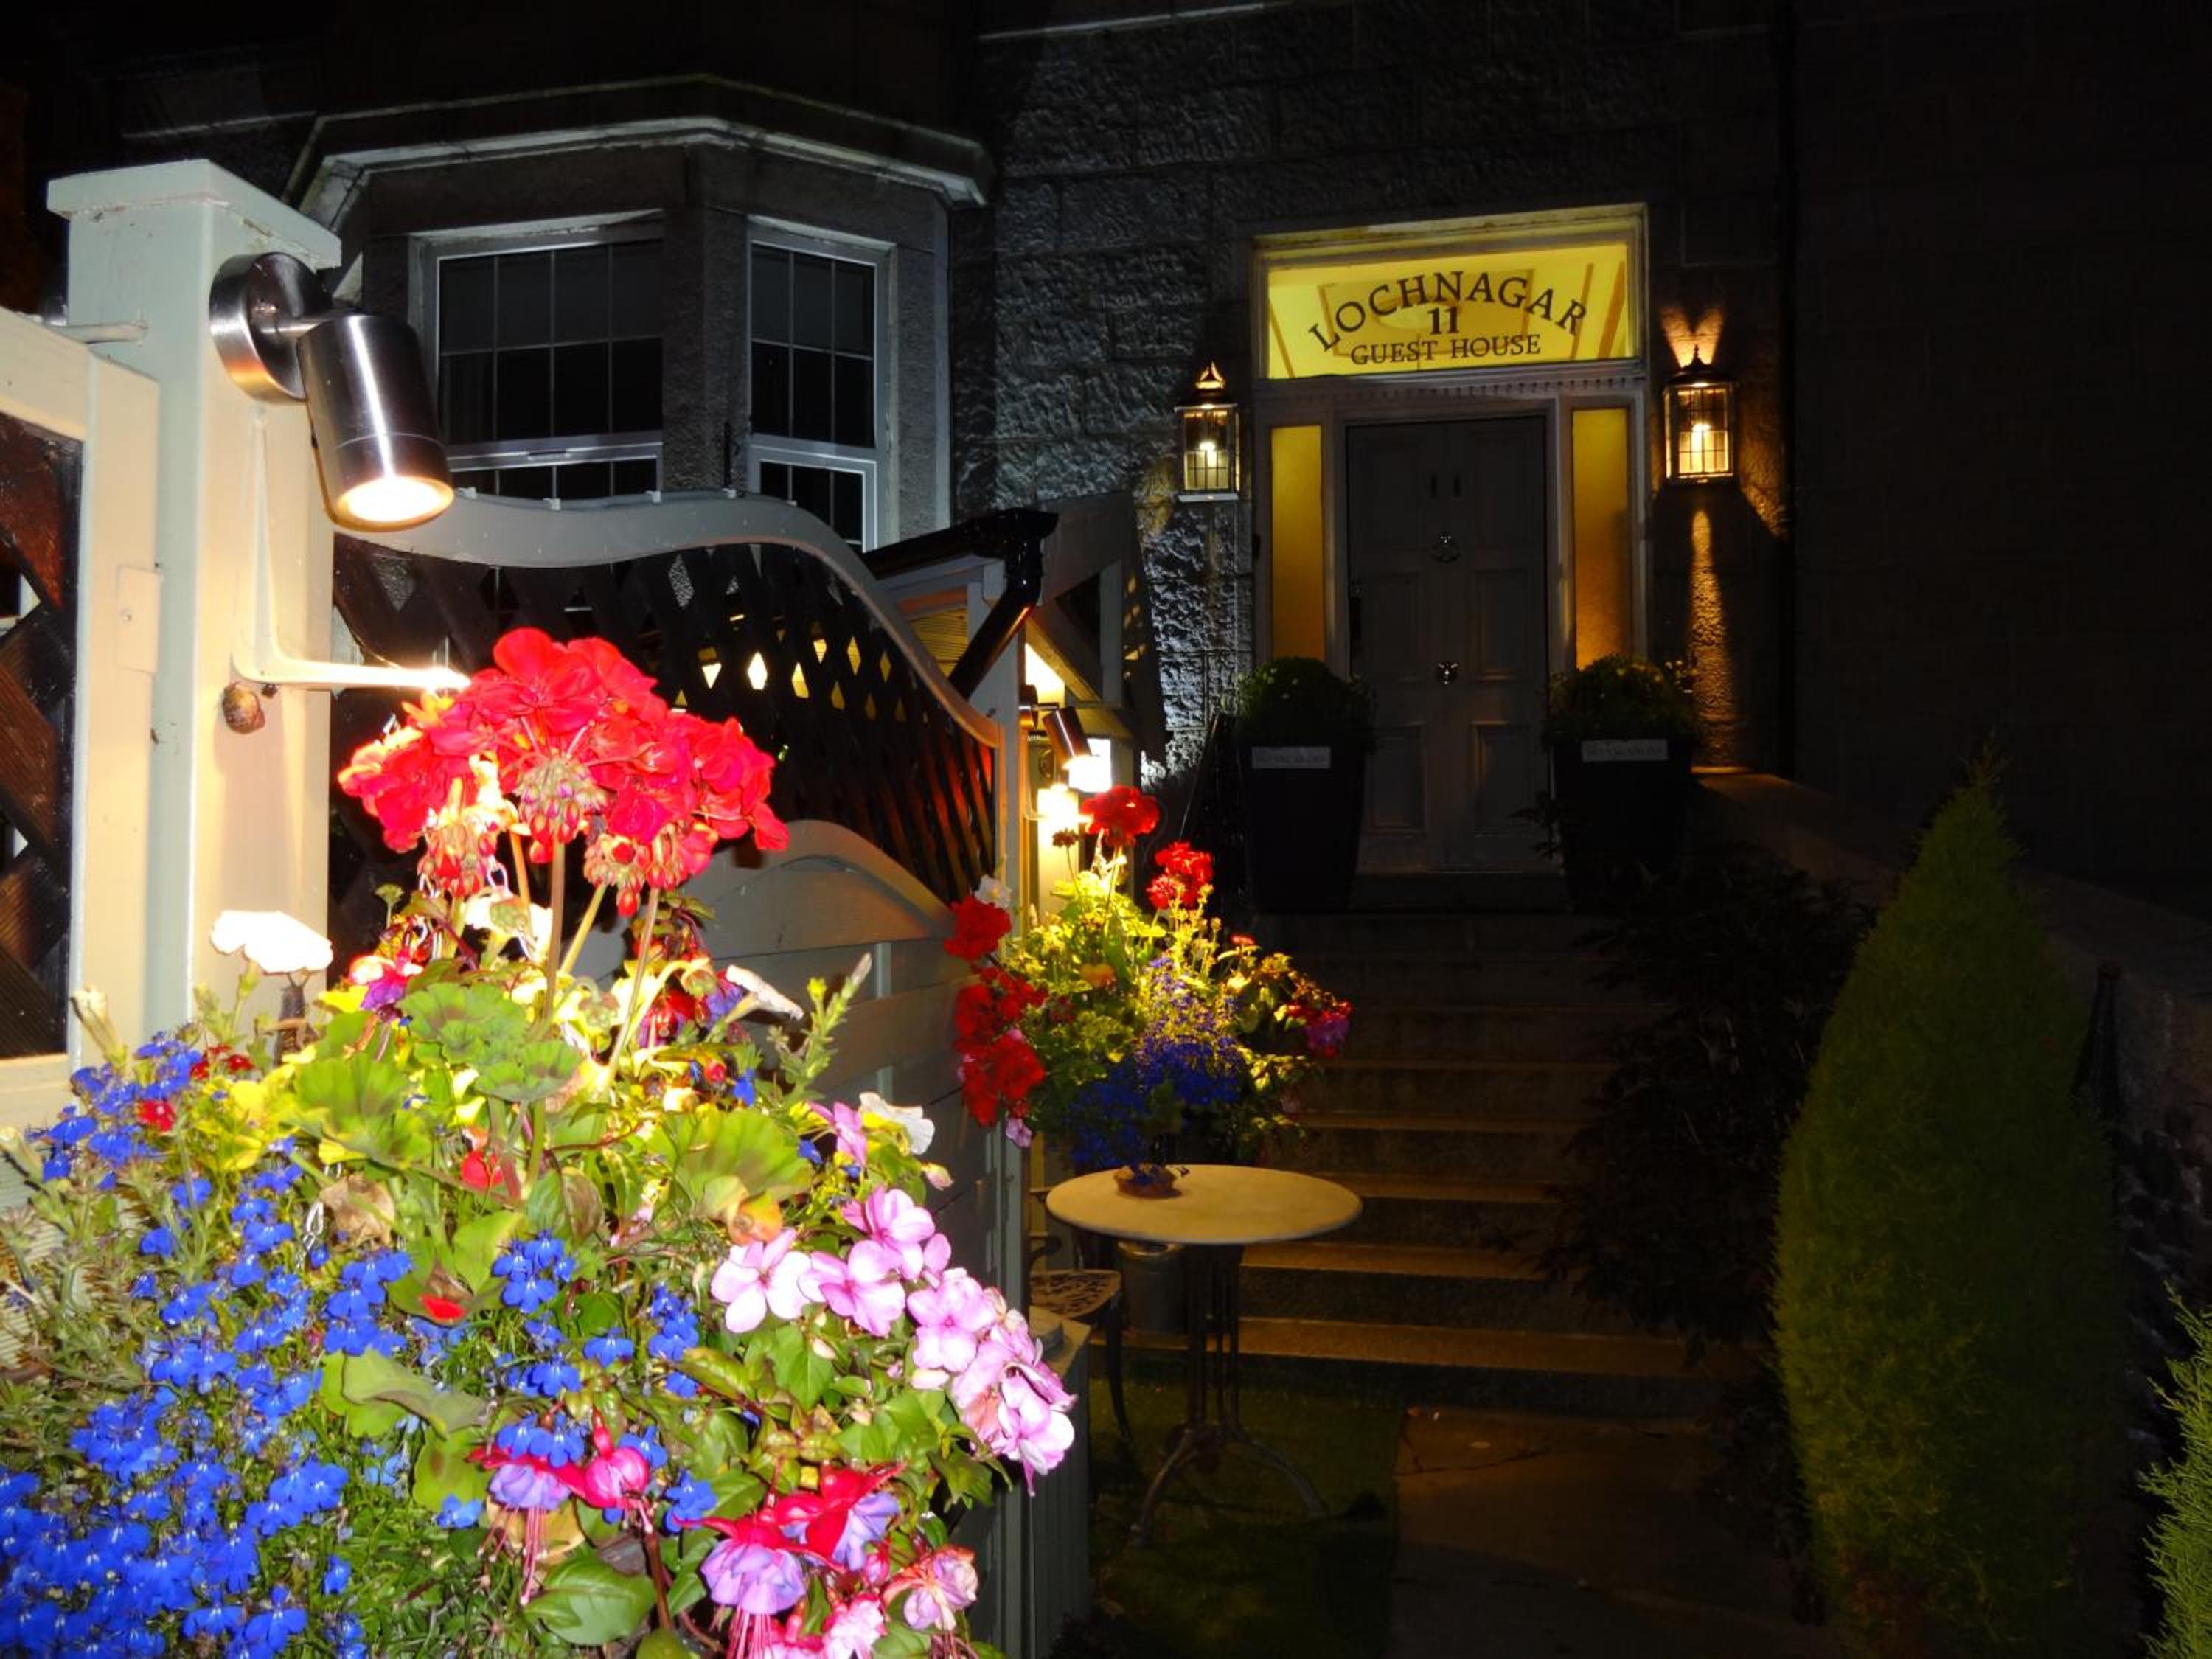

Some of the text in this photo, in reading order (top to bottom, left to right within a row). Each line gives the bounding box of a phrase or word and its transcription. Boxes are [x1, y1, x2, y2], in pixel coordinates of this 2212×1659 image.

[1309, 271, 1587, 352] LOCHNAGAR
[1429, 307, 1459, 335] 11
[1352, 335, 1541, 365] GUEST HOUSE
